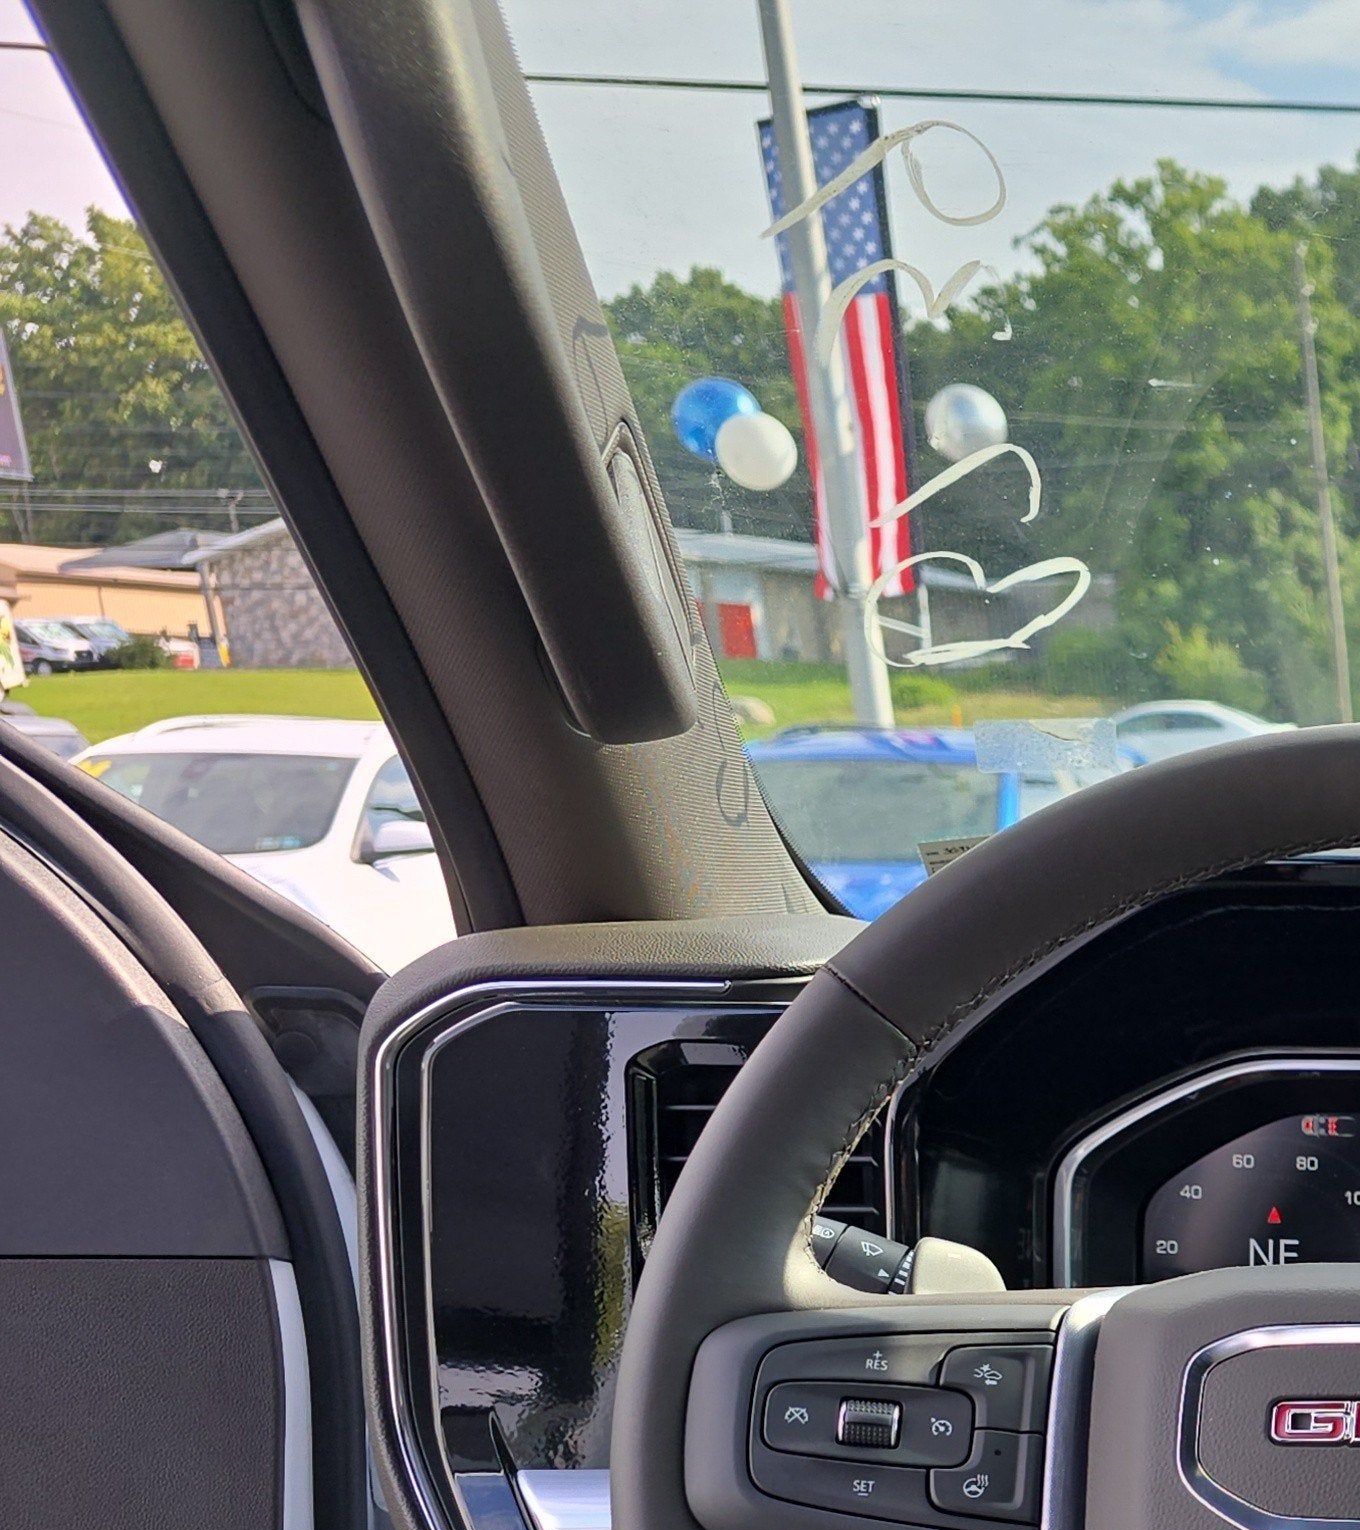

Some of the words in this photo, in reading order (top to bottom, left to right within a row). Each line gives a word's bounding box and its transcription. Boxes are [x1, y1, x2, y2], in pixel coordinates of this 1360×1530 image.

[1232, 1154, 1255, 1169] 60
[1296, 1156, 1319, 1171] 80
[1180, 1185, 1202, 1200] 40
[1156, 1240, 1178, 1255] 20
[865, 1358, 888, 1371] RES
[852, 1480, 875, 1493] SET
